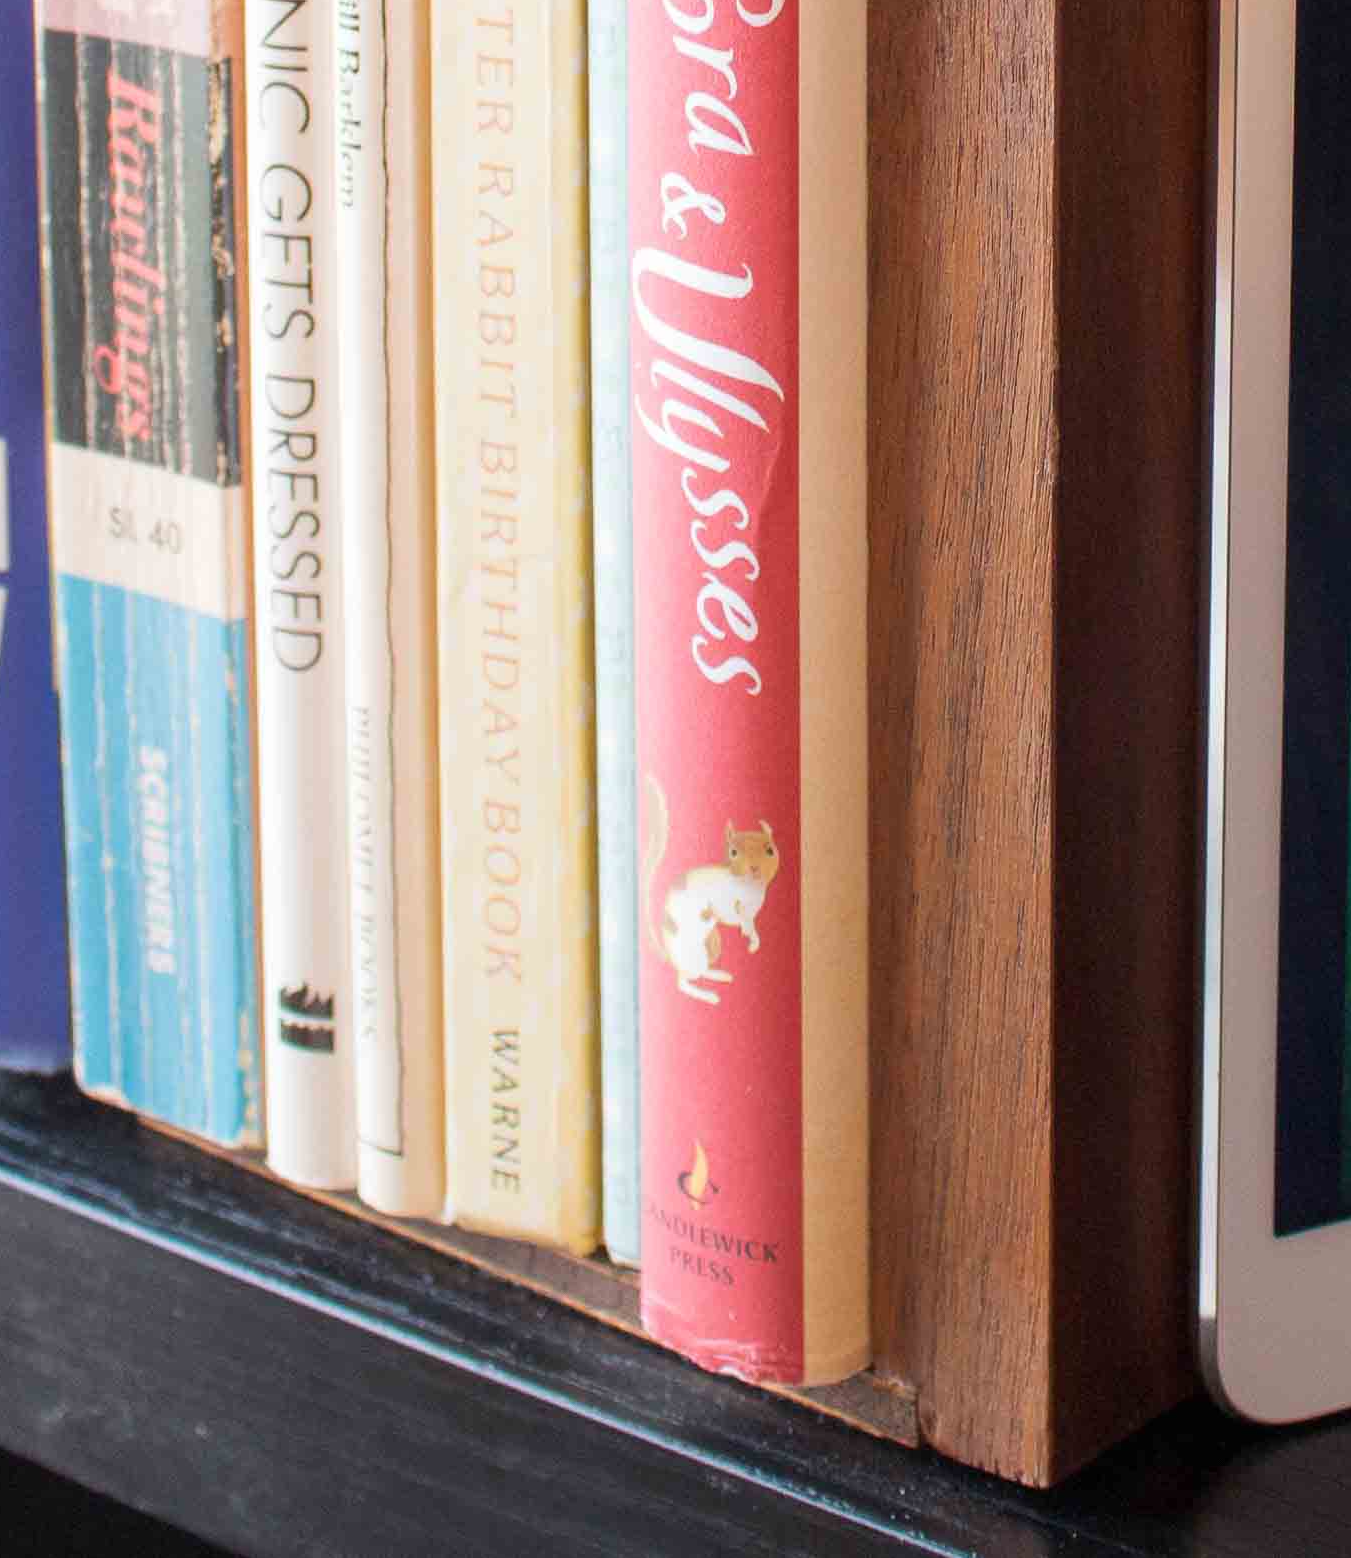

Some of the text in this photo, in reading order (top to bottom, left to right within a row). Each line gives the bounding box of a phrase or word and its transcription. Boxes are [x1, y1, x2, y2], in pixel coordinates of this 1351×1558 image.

[96, 67, 165, 445] Rawlings
[260, 163, 317, 342] GETS
[475, 161, 517, 421] RABBIT
[659, 171, 727, 242] &
[261, 374, 325, 673] DRESSED
[632, 242, 786, 698] Ulysses
[478, 437, 522, 787] BIRTHDAY
[139, 743, 178, 976] SCRIBNERS
[481, 800, 524, 984] BOOK
[490, 1023, 523, 1193] WARNE
[669, 1246, 738, 1287] PRESS
